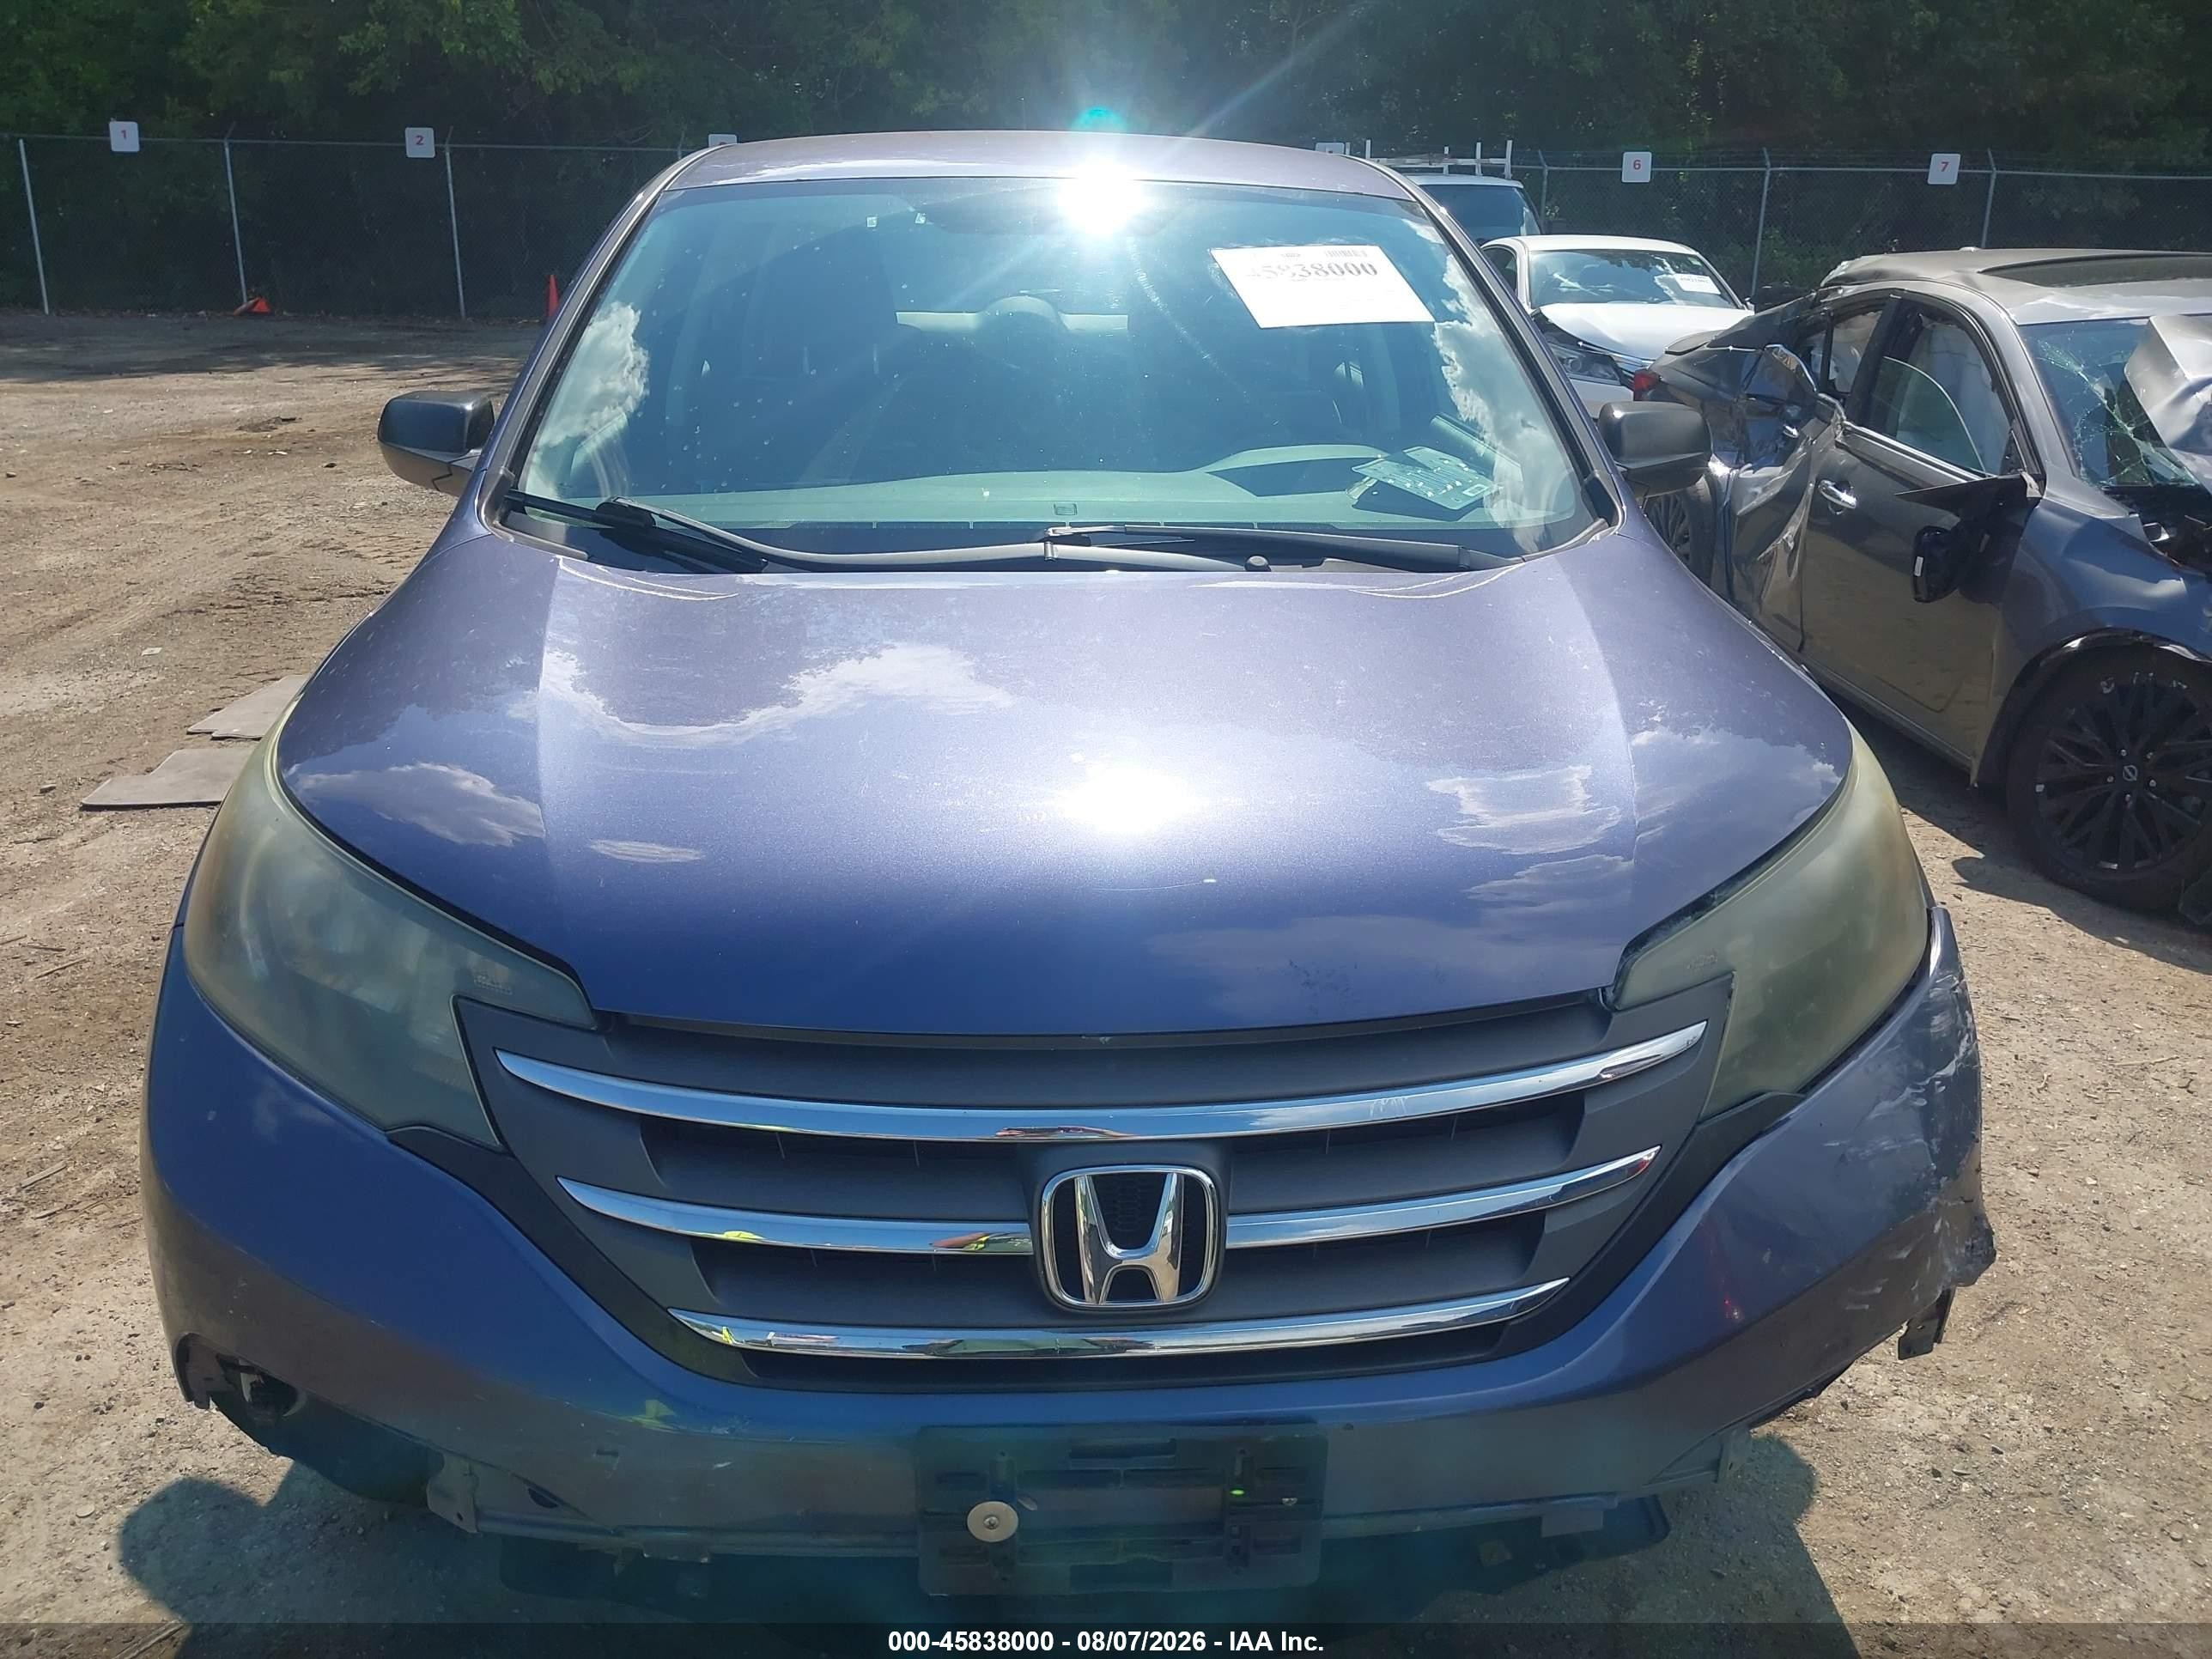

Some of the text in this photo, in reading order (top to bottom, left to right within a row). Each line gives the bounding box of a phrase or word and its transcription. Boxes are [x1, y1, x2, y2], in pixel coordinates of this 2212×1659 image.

[120, 130, 127, 139] 1
[416, 134, 424, 145] 2
[1633, 159, 1642, 170] 6
[1941, 161, 1949, 172] 7
